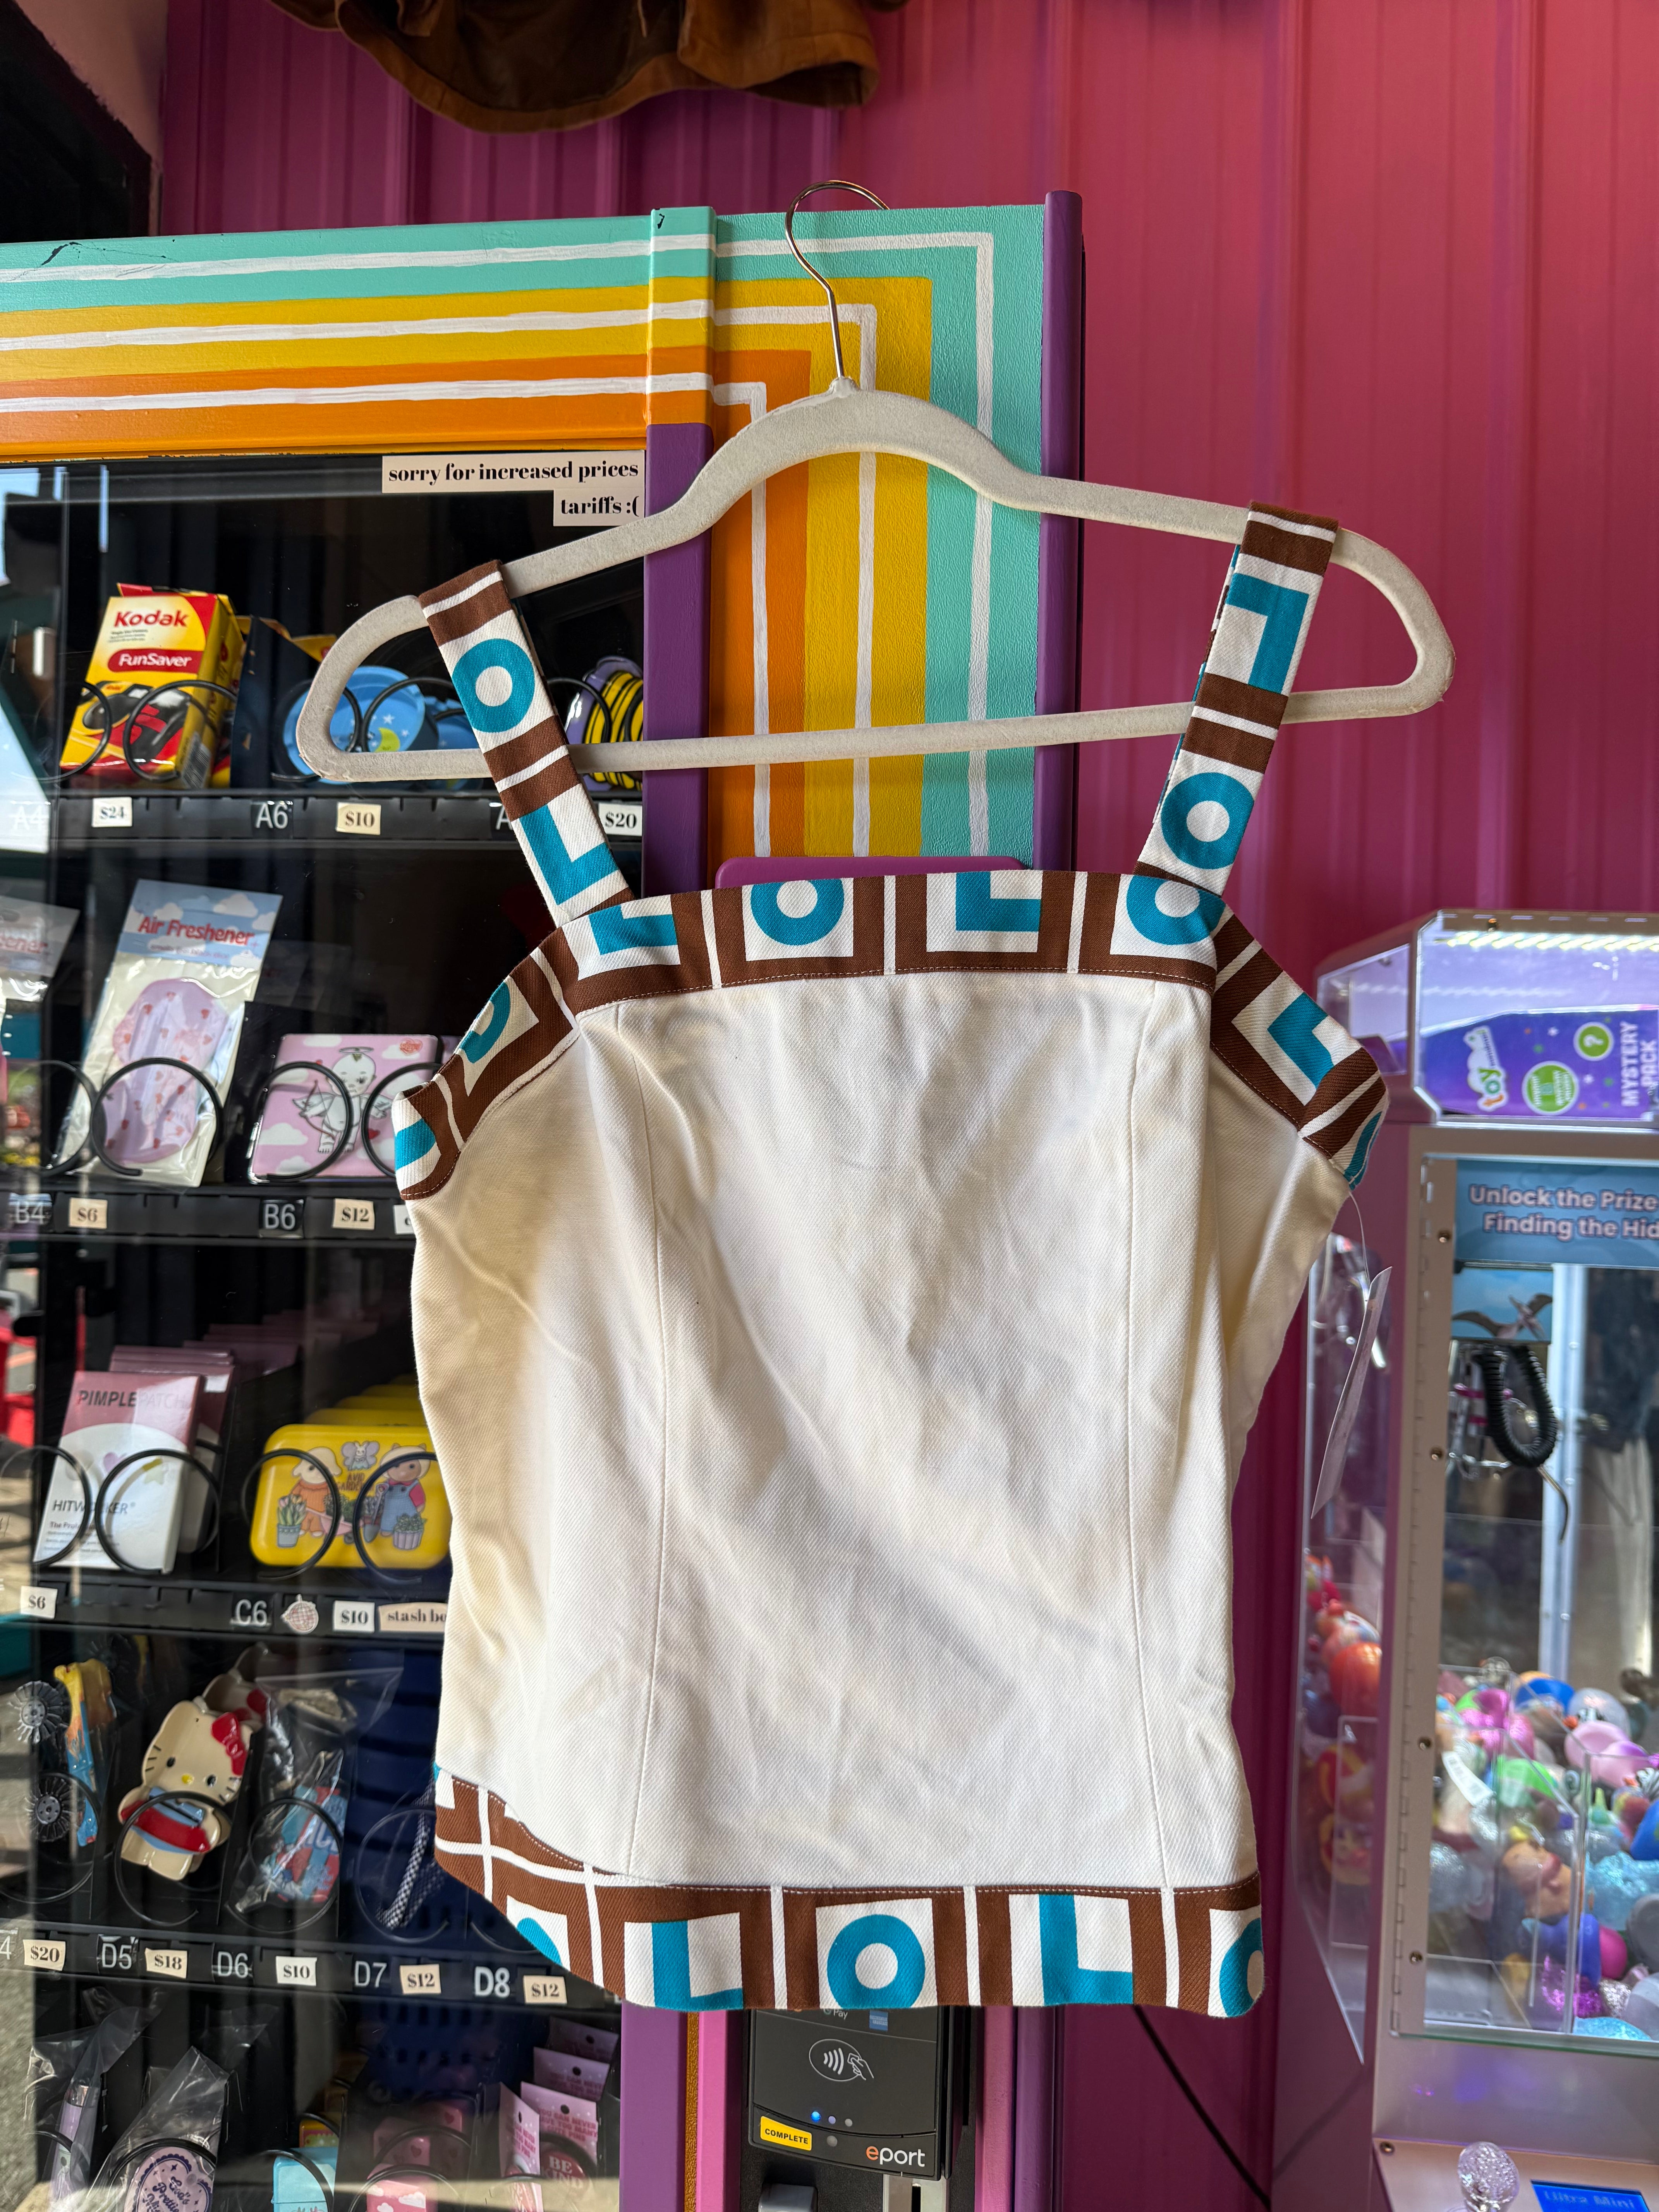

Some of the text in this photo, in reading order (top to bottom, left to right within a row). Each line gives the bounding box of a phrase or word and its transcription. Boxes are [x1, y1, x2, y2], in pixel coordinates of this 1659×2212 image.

[388, 460, 639, 485] sorry for increased prices
[561, 496, 621, 515] tariffs
[113, 610, 189, 628] Kodak
[118, 653, 192, 667] FunSaver
[100, 806, 125, 819] $24
[255, 804, 289, 830] A6
[345, 810, 375, 828] $10
[496, 805, 512, 830] A
[605, 811, 636, 829] $20
[137, 915, 255, 946] Air Freshener
[1619, 1020, 1640, 1107] MYSTERY
[1469, 1183, 1659, 1212] Unlock the Prize
[15, 1200, 45, 1224] B4
[77, 1207, 98, 1223] $6
[264, 1203, 296, 1230] B6
[341, 1207, 370, 1222] $12
[1483, 1211, 1573, 1242] Finding
[1577, 1216, 1619, 1237] the
[77, 1390, 137, 1407] PIMPLE
[28, 1595, 46, 1610] $6
[235, 1599, 268, 1626] C6
[341, 1609, 369, 1624] $10
[388, 1608, 426, 1621] stash
[30, 1945, 60, 1963] $20
[101, 1943, 132, 1970] D5
[154, 1955, 182, 1970] $18
[217, 1952, 249, 1978] D6
[283, 1966, 310, 1979] $10
[355, 1961, 387, 1987] D7
[407, 1973, 435, 1988] $12
[474, 1966, 511, 1998] D8
[531, 1983, 560, 1998] $12
[833, 2009, 848, 2020] Pay
[764, 2128, 809, 2145] COMPLETE
[549, 2156, 572, 2174] BE
[866, 2146, 926, 2167] eport
